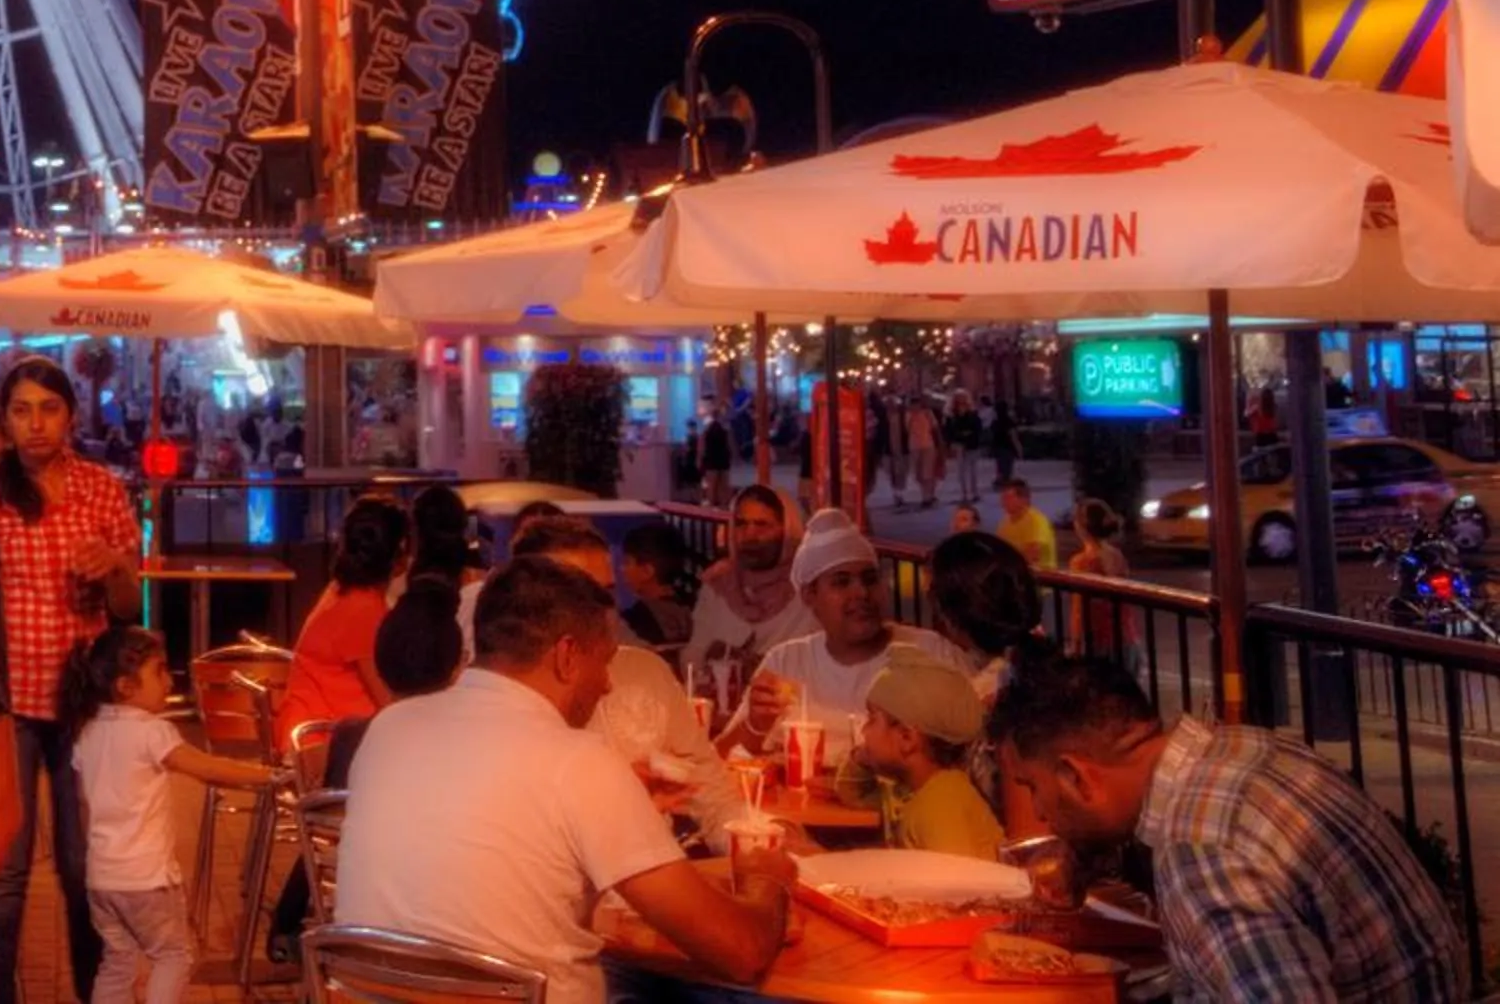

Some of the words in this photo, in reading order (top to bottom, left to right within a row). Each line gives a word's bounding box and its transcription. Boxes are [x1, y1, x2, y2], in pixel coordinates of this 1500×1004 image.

[150, 25, 203, 104] LIVE
[358, 26, 409, 101] LIVE
[225, 141, 263, 180] A
[432, 136, 469, 172] A
[206, 170, 249, 219] BE
[413, 163, 455, 210] BE
[936, 211, 1138, 264] CANADIAN
[1103, 354, 1156, 374] PUBLIC
[1104, 377, 1159, 394] PARKING
